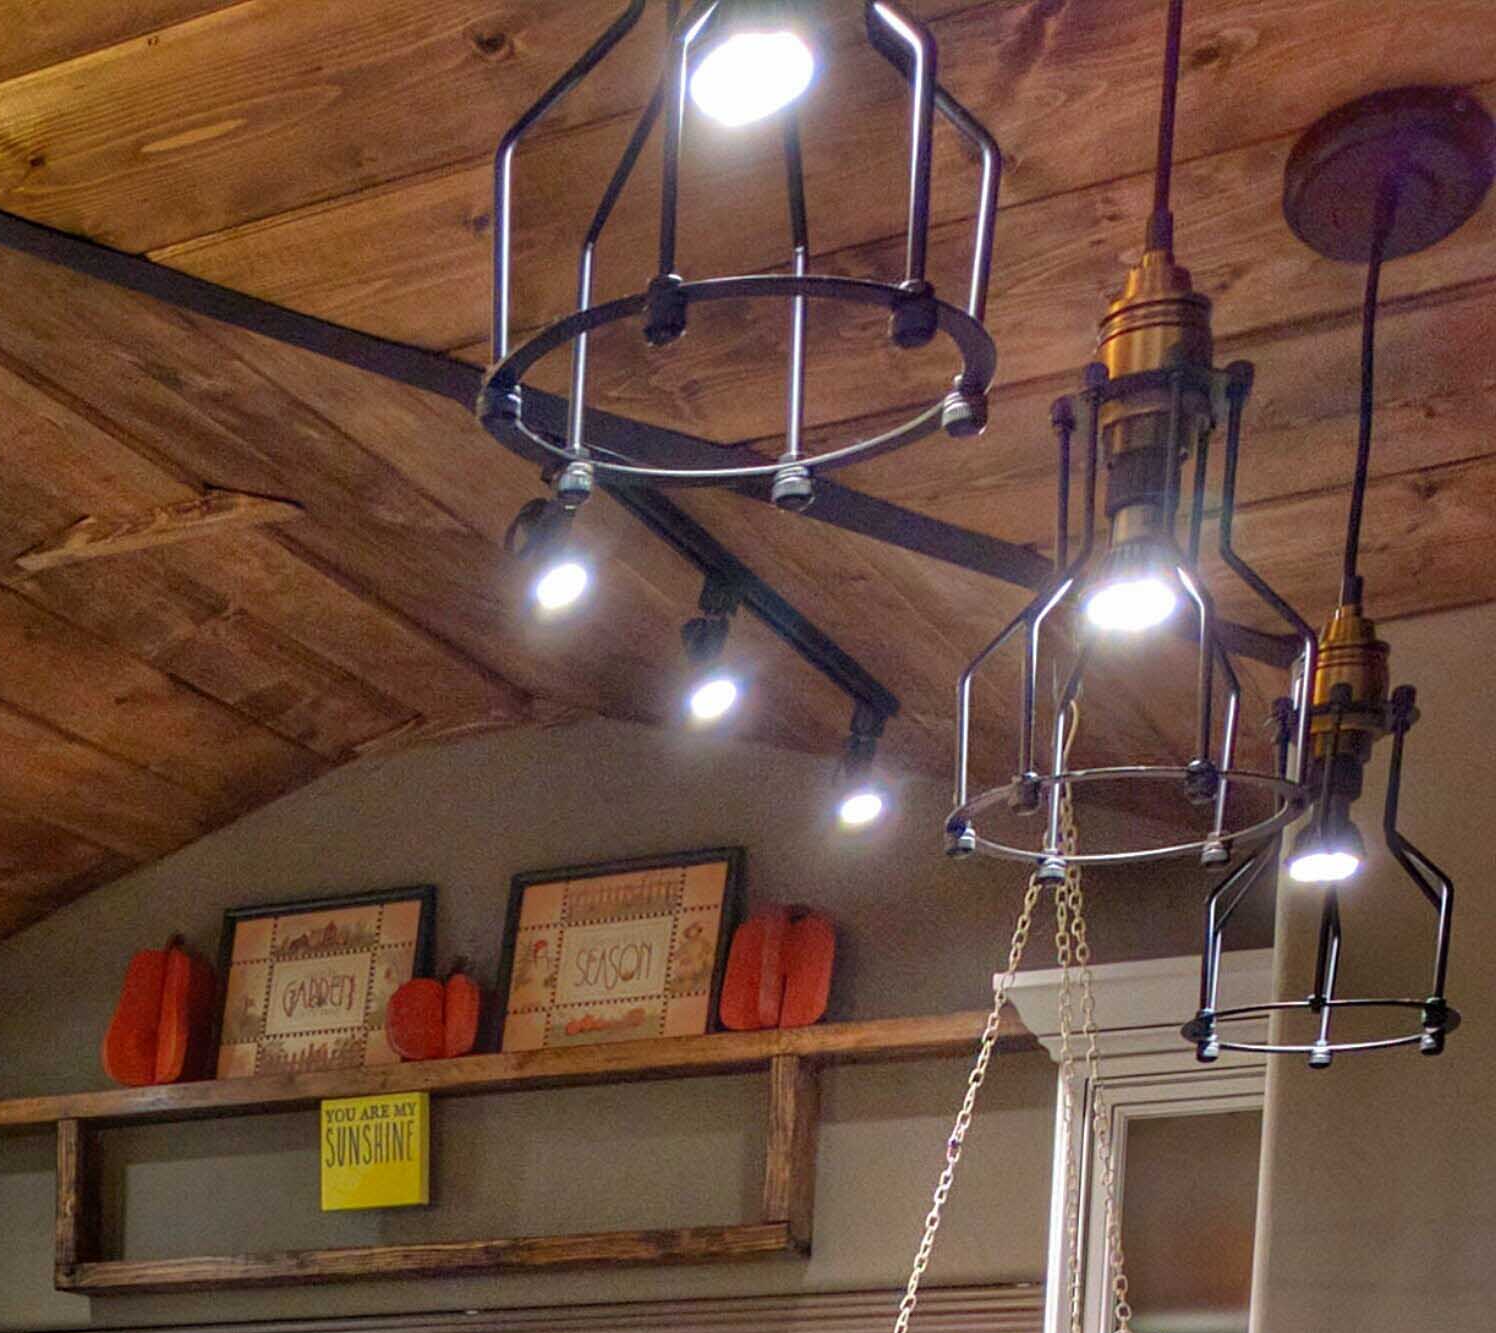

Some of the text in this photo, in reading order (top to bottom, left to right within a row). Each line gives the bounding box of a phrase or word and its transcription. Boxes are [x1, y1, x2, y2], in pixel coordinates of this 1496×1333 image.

[574, 942, 653, 991] SEASON
[283, 975, 355, 1017] GARDEN
[325, 1102, 416, 1122] YOU ARE MY
[325, 1120, 415, 1168] SUNSHINE
